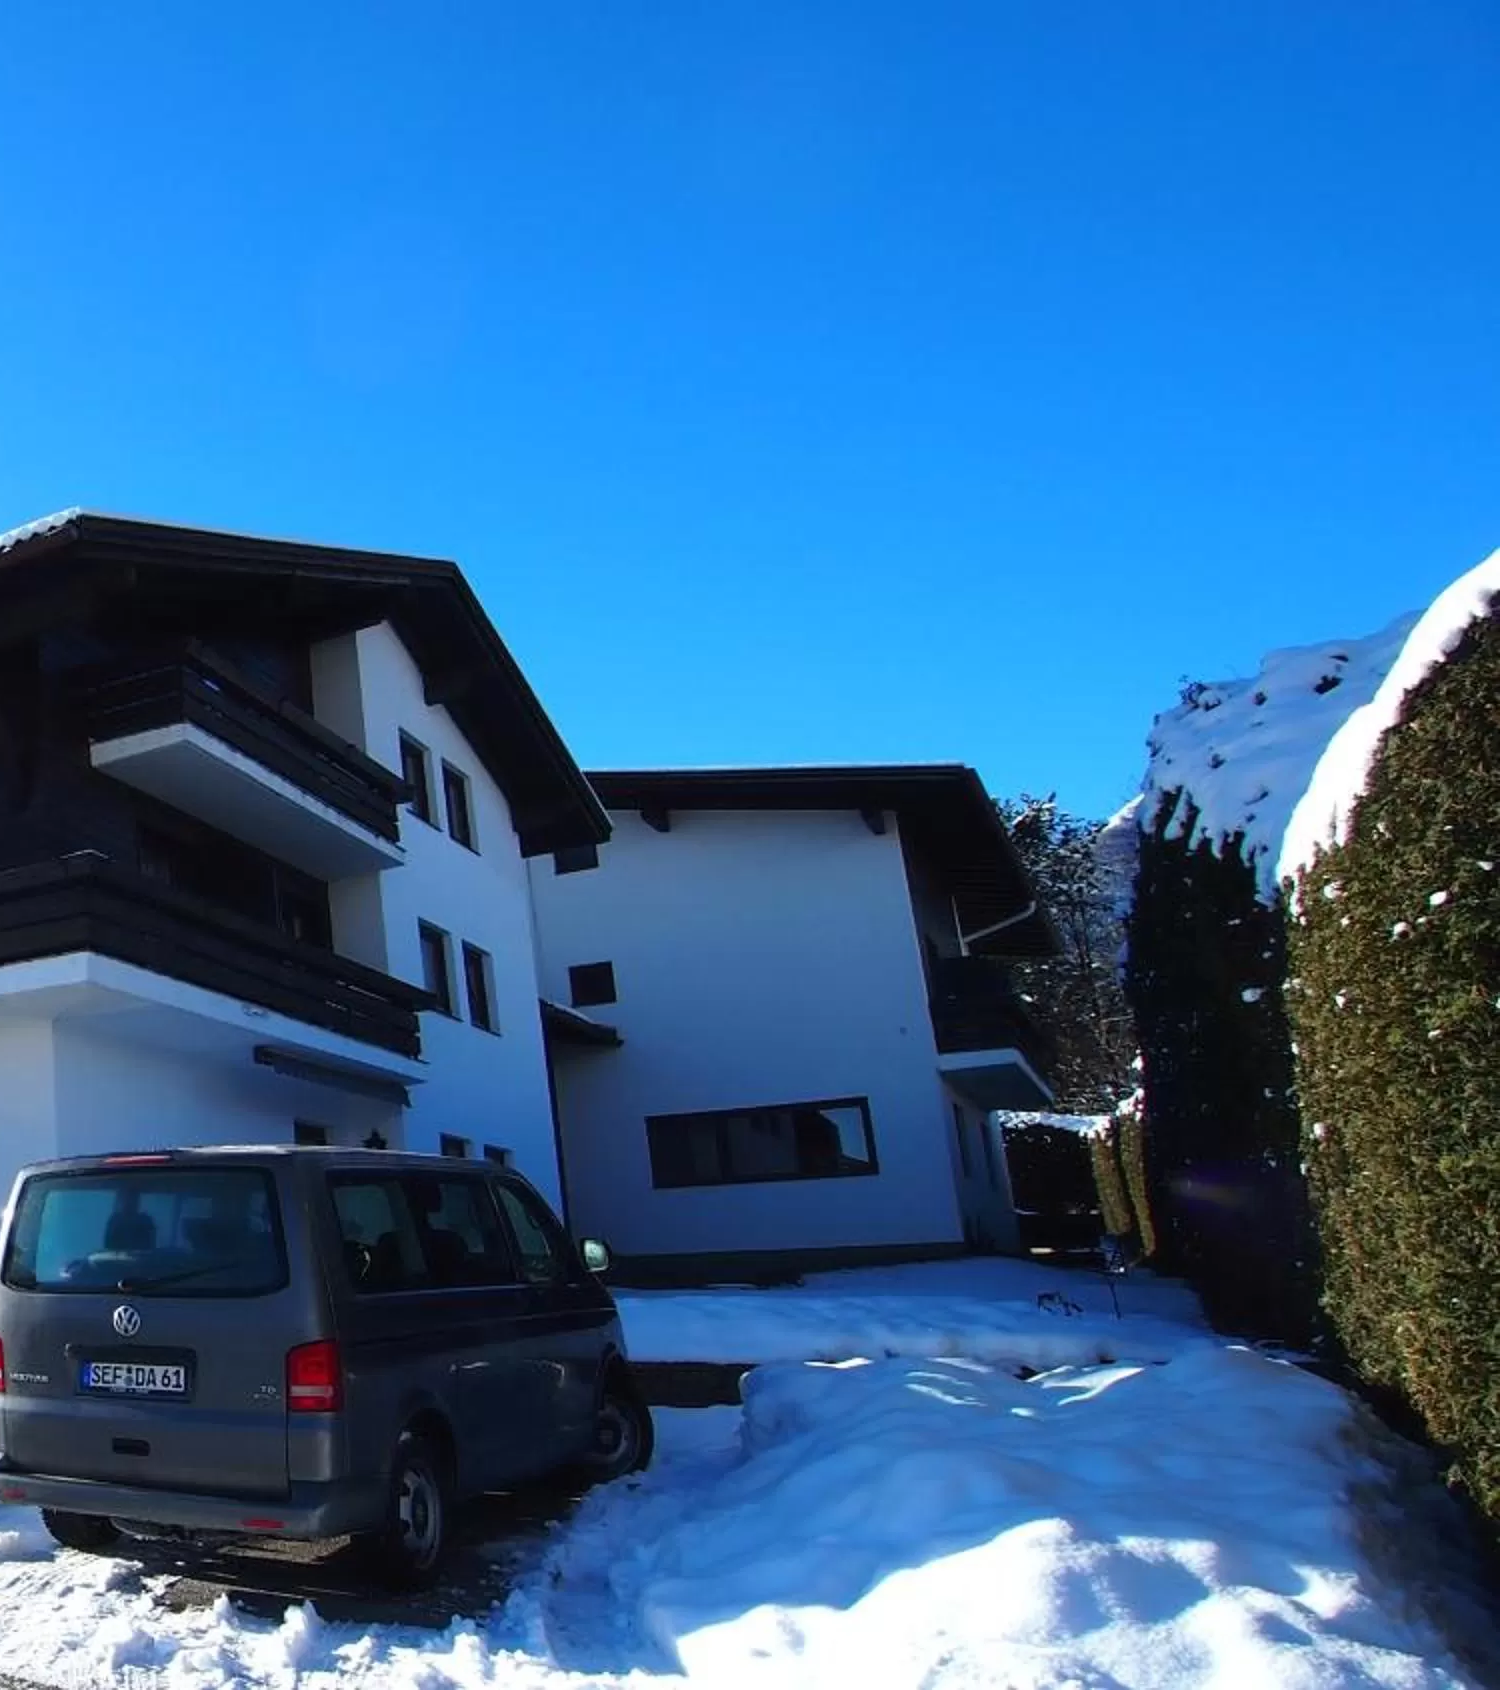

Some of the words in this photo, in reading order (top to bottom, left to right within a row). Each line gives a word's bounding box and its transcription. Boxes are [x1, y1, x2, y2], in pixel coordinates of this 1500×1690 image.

[91, 1365, 122, 1385] SEF
[135, 1367, 157, 1387] DA
[161, 1369, 183, 1389] 61
